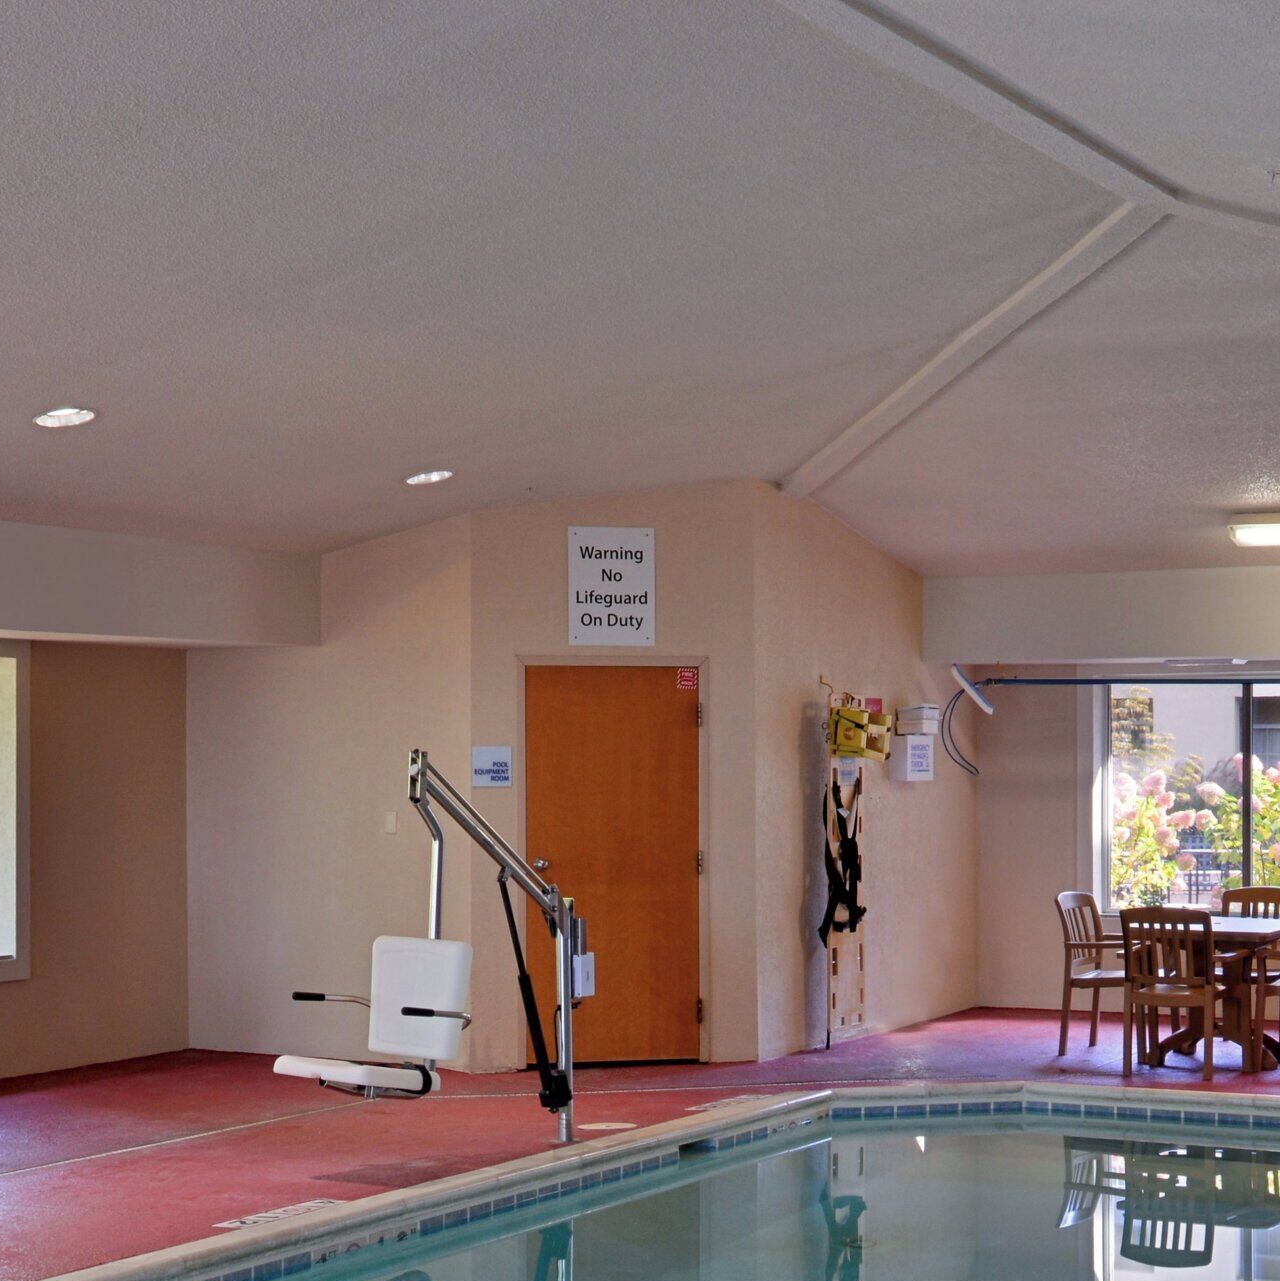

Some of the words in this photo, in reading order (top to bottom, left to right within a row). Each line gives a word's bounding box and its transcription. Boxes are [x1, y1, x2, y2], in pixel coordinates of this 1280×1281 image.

[579, 546, 643, 564] Warning
[601, 569, 623, 582] No
[575, 590, 648, 608] Lifeguard
[580, 612, 602, 626] On
[607, 613, 644, 631] Duty
[474, 768, 509, 776] EQUIPMENT
